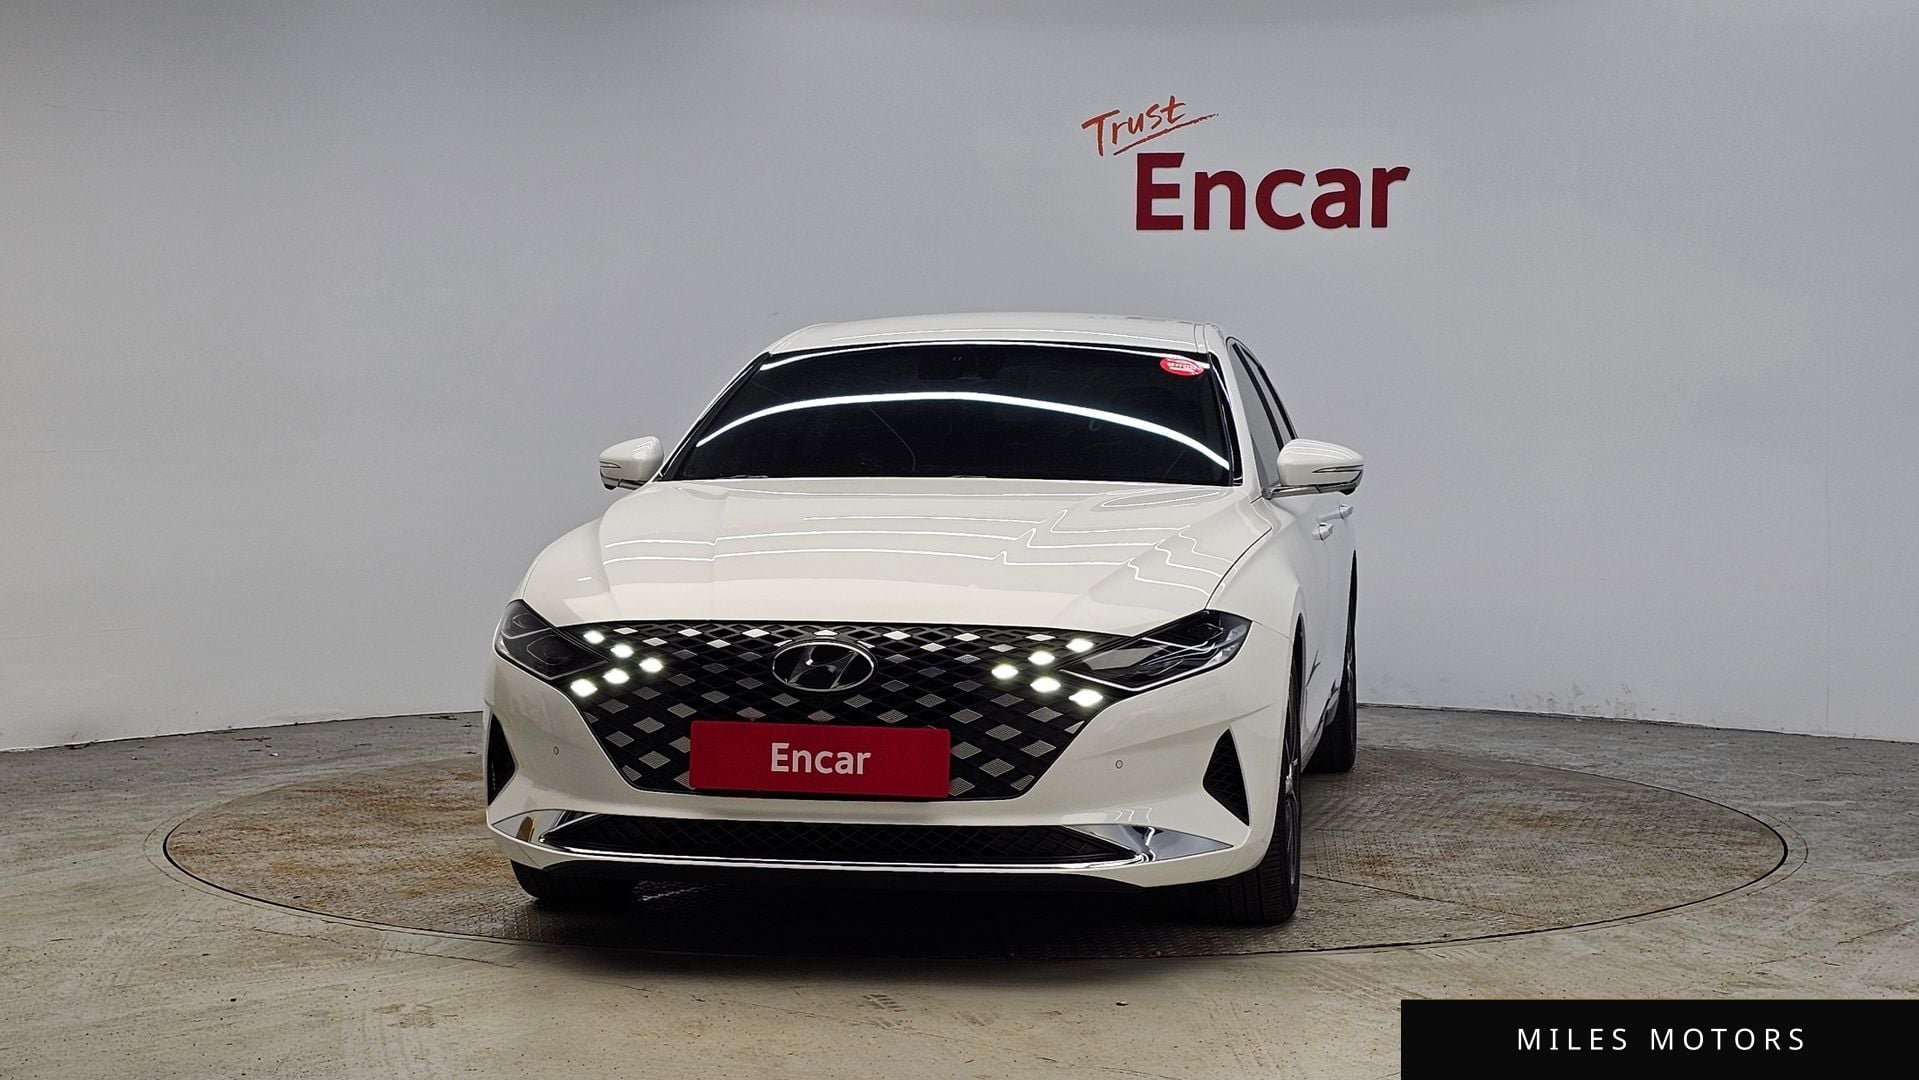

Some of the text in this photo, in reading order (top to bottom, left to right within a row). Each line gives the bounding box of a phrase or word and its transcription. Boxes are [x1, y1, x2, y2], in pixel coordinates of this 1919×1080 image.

[1081, 95, 1186, 157] Trust
[1136, 152, 1411, 231] Encar
[770, 742, 872, 775] Encar
